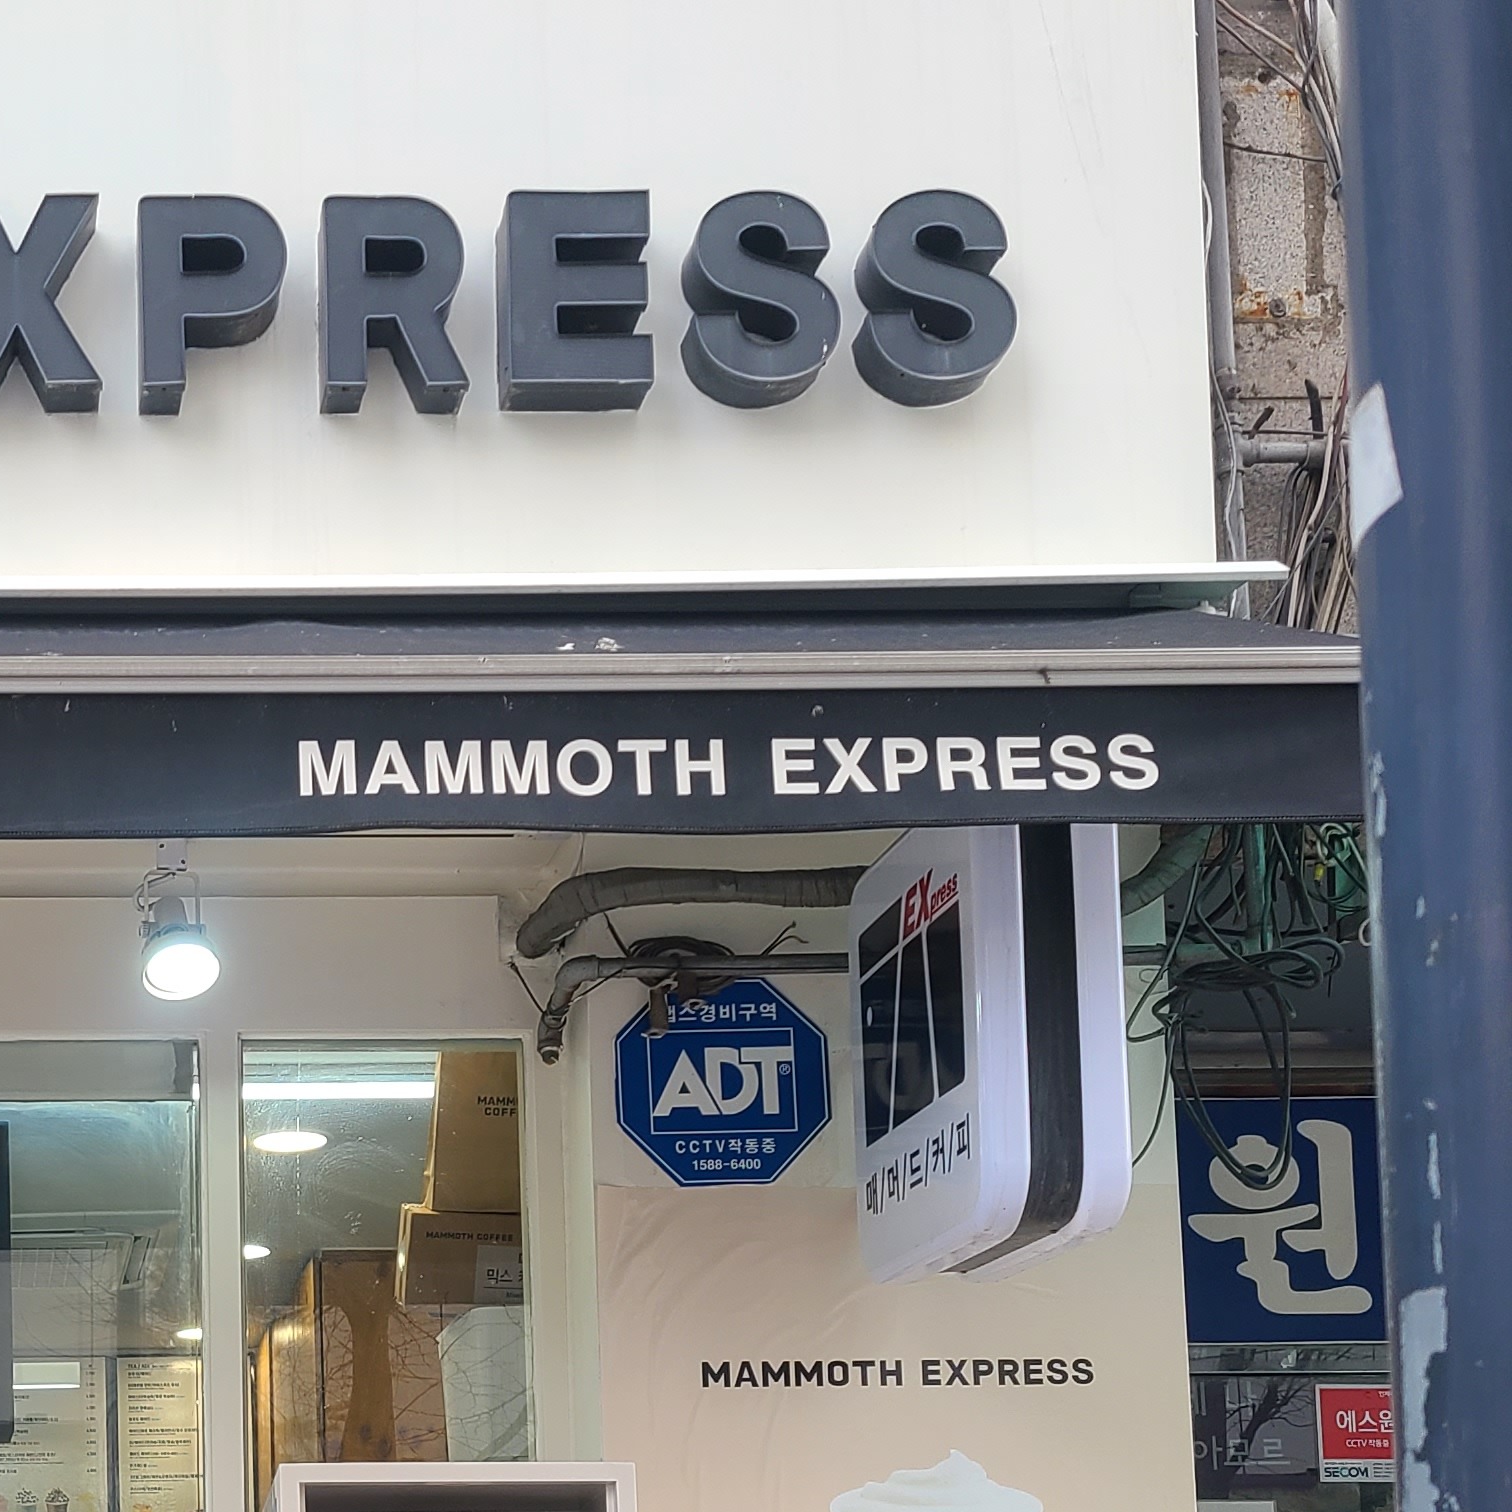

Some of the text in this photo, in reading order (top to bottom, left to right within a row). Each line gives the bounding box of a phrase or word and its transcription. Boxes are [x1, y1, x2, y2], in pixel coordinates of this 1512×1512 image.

[297, 733, 1161, 797] MAMMOTH EXPRESS
[652, 1045, 794, 1117] ADT
[477, 1096, 518, 1106] MAMM
[692, 1158, 762, 1171] 1588-6400
[425, 1231, 514, 1243] MAMMOTH COFFEE
[700, 1358, 1095, 1388] MAMMOTH EXPRESS
[1324, 1466, 1369, 1478] SECOM
